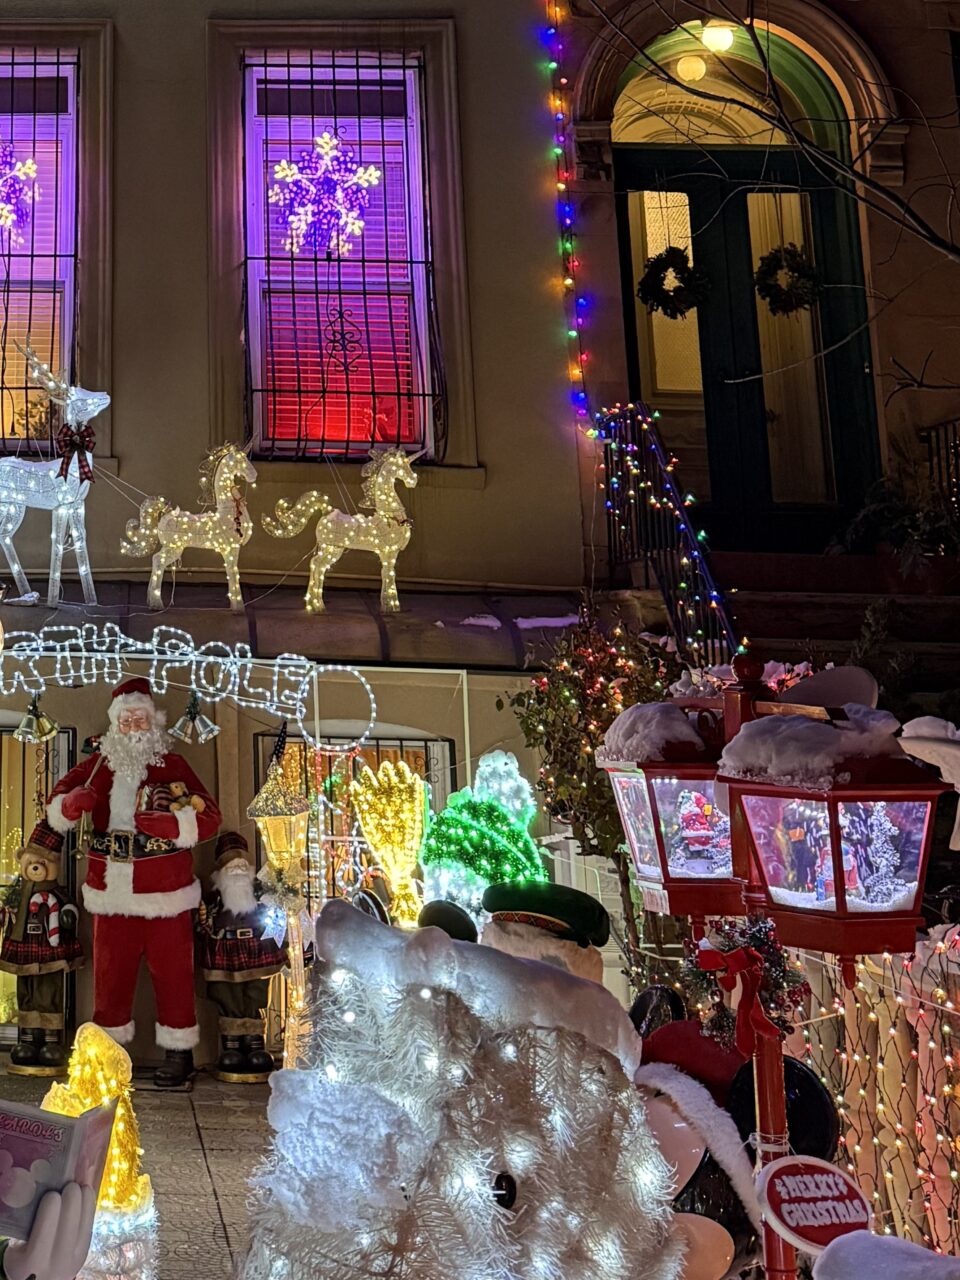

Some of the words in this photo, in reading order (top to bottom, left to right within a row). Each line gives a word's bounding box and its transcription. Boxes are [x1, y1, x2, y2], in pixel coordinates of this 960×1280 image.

[149, 624, 309, 720] POLE
[784, 1174, 837, 1197] MERRY
[781, 1199, 868, 1226] CHRISTMAS
